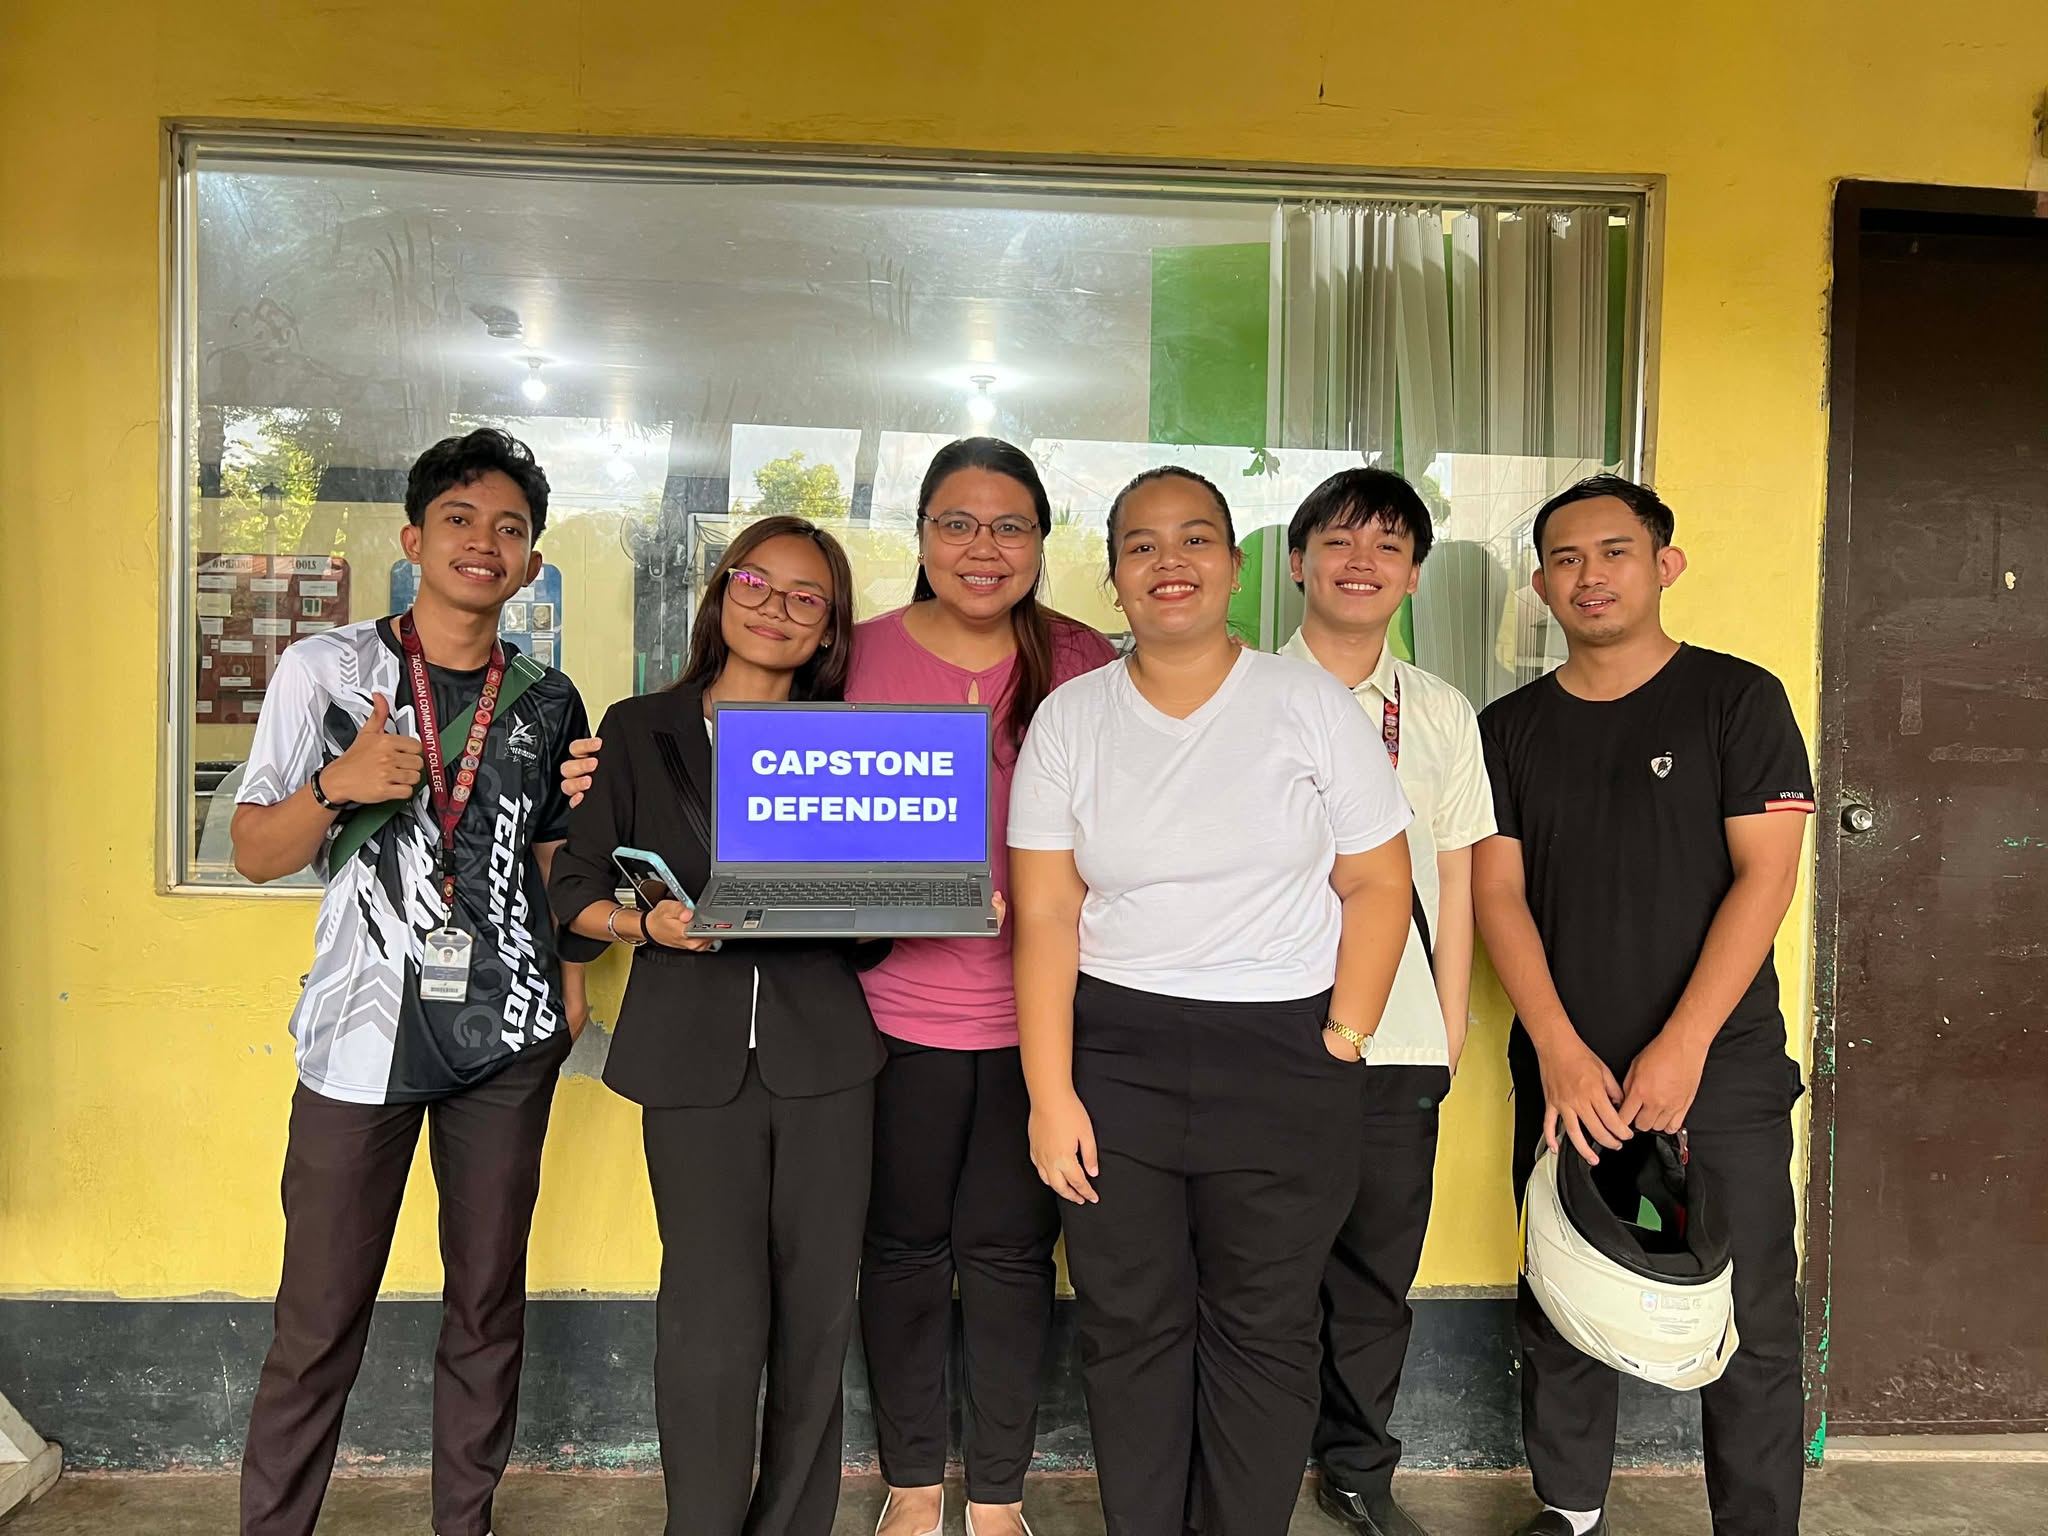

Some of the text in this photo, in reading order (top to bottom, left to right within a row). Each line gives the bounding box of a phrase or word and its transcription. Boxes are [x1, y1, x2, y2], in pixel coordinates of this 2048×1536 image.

[411, 653, 444, 793] TAGOLOAN COMMUNITY COLLEGE
[751, 749, 954, 776] CAPSTONE
[748, 796, 958, 822] DEFENDED!
